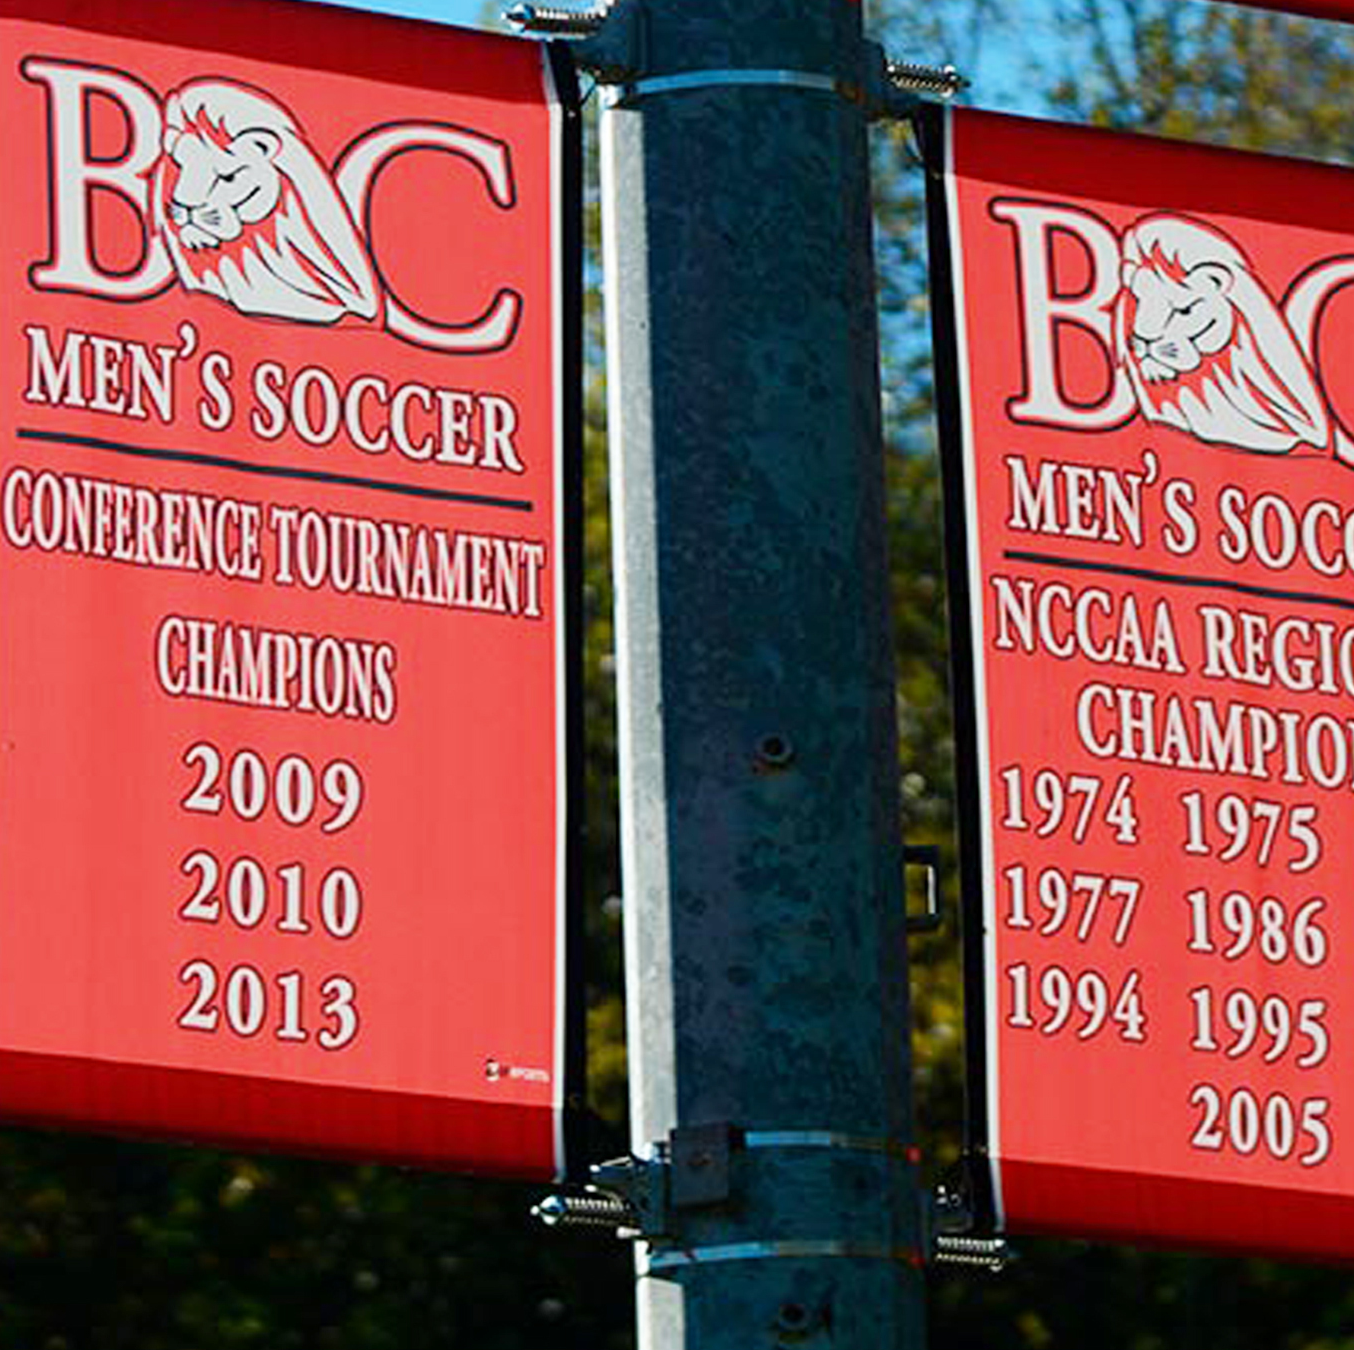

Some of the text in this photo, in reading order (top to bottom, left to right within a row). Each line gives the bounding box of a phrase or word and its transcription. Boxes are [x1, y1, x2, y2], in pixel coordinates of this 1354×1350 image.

[24, 322, 525, 474] MEN’S SOCCER
[2, 468, 545, 618] CONFERENCE TOURNAMENT
[1005, 450, 1198, 555] MEN’S
[156, 616, 395, 723] CHAMPIONS
[991, 576, 1186, 675] NCCAA
[183, 743, 362, 833] 2009
[1001, 766, 1138, 844] 1974
[1181, 791, 1320, 872] 1975
[181, 851, 360, 938] 2010
[1005, 865, 1141, 944] 1977
[1186, 889, 1327, 967] 1986
[179, 961, 358, 1049] 2013
[1007, 963, 1146, 1041] 1994
[1190, 987, 1329, 1068] 1995
[1190, 1084, 1330, 1166] 2005
